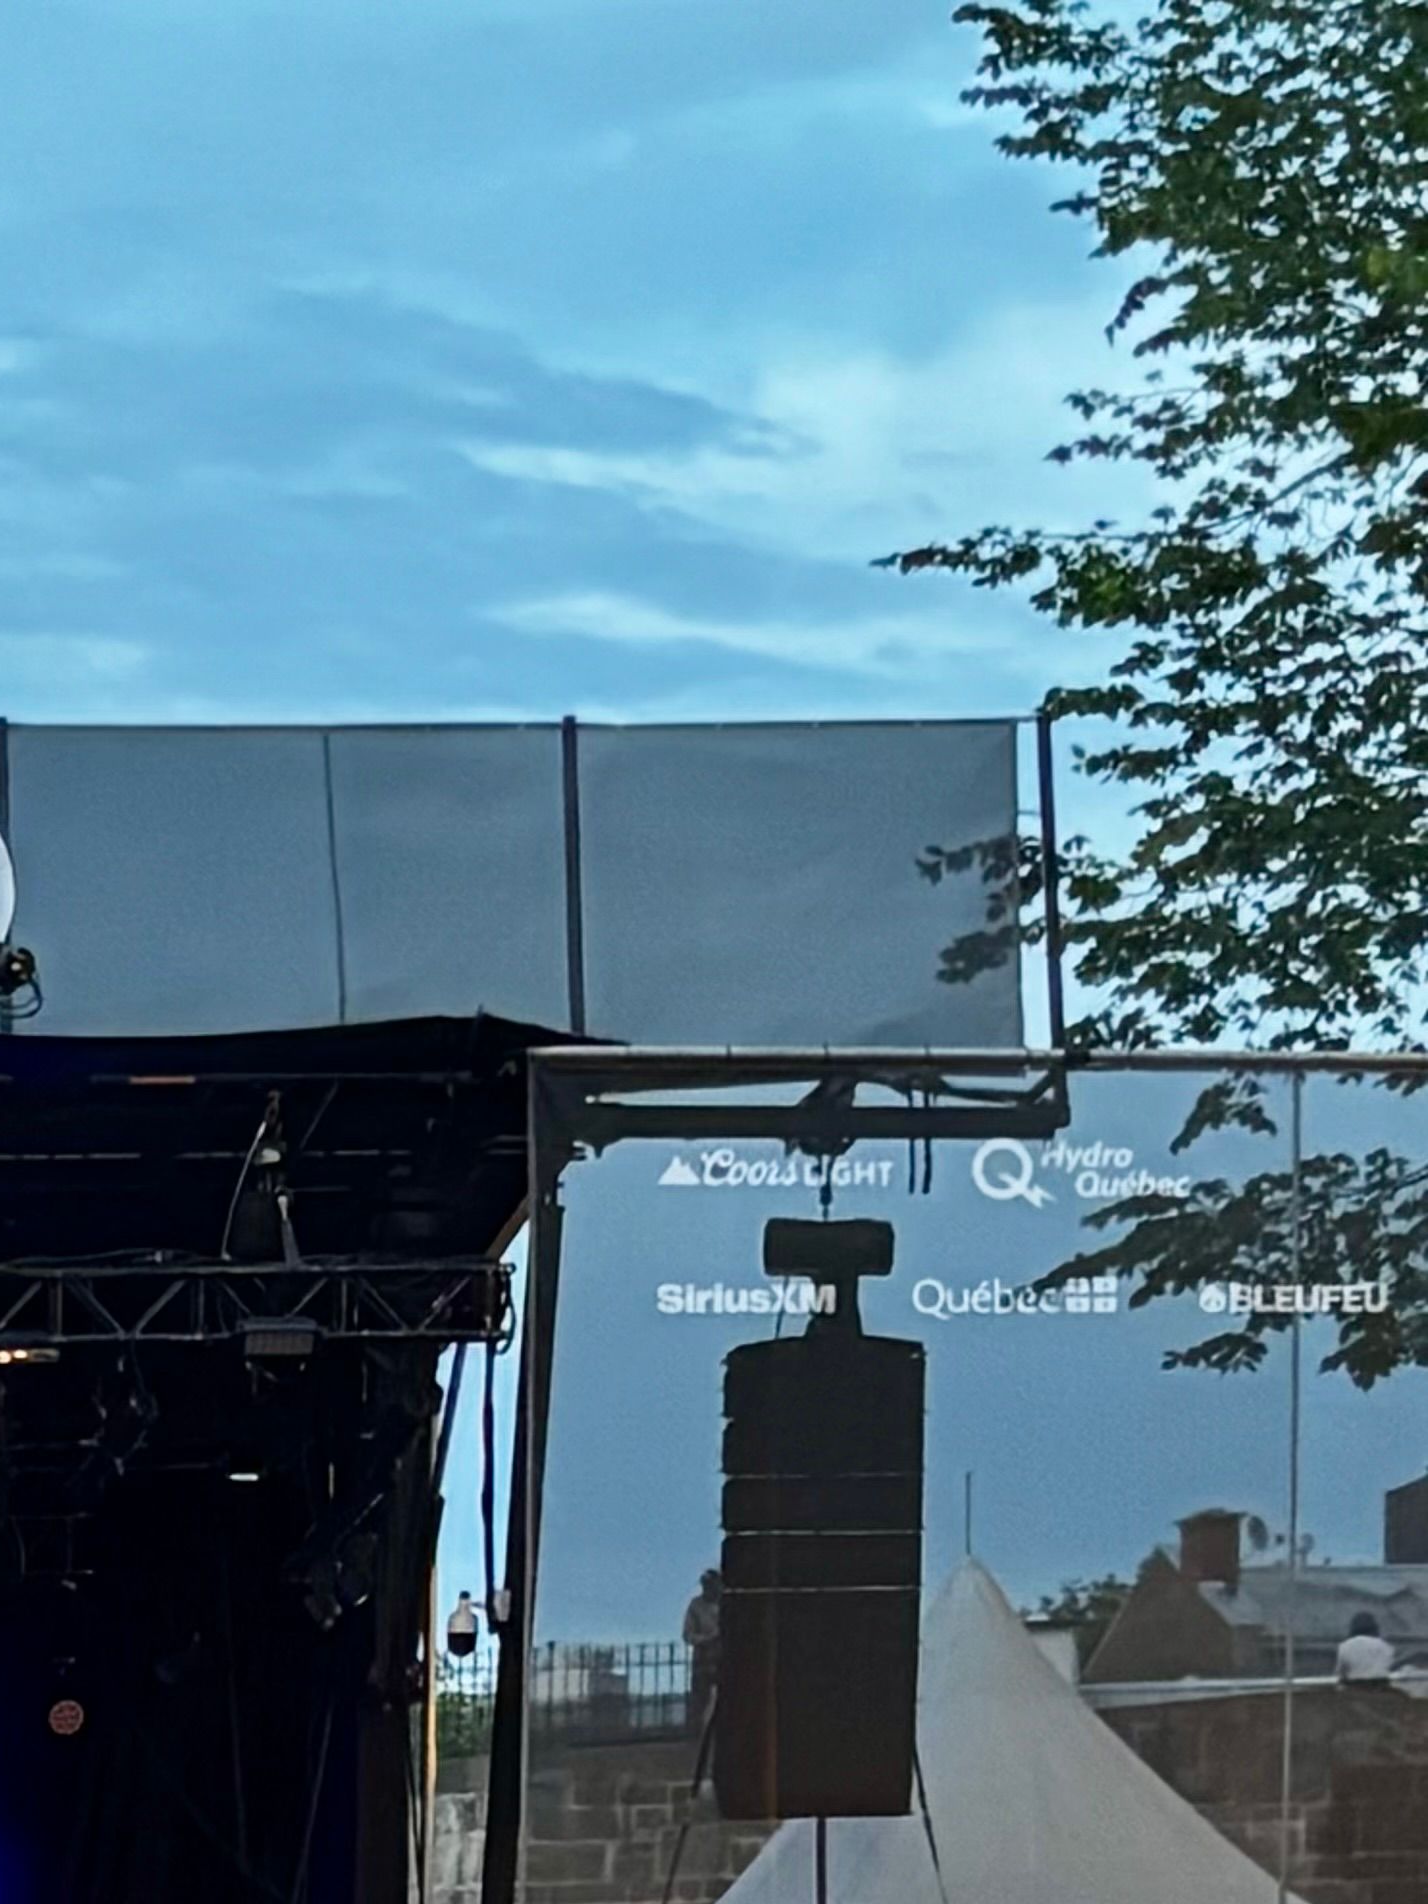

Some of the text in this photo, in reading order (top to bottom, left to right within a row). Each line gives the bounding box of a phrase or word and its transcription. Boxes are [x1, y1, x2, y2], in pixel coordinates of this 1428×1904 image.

[700, 1148, 894, 1187] Coors LIGHT
[1041, 1140, 1134, 1174] Hydro
[1074, 1168, 1191, 1198] Québec
[656, 1282, 837, 1315] SiriusXM
[911, 1276, 1062, 1320] Québec
[1228, 1281, 1389, 1314] BLEUFEU
